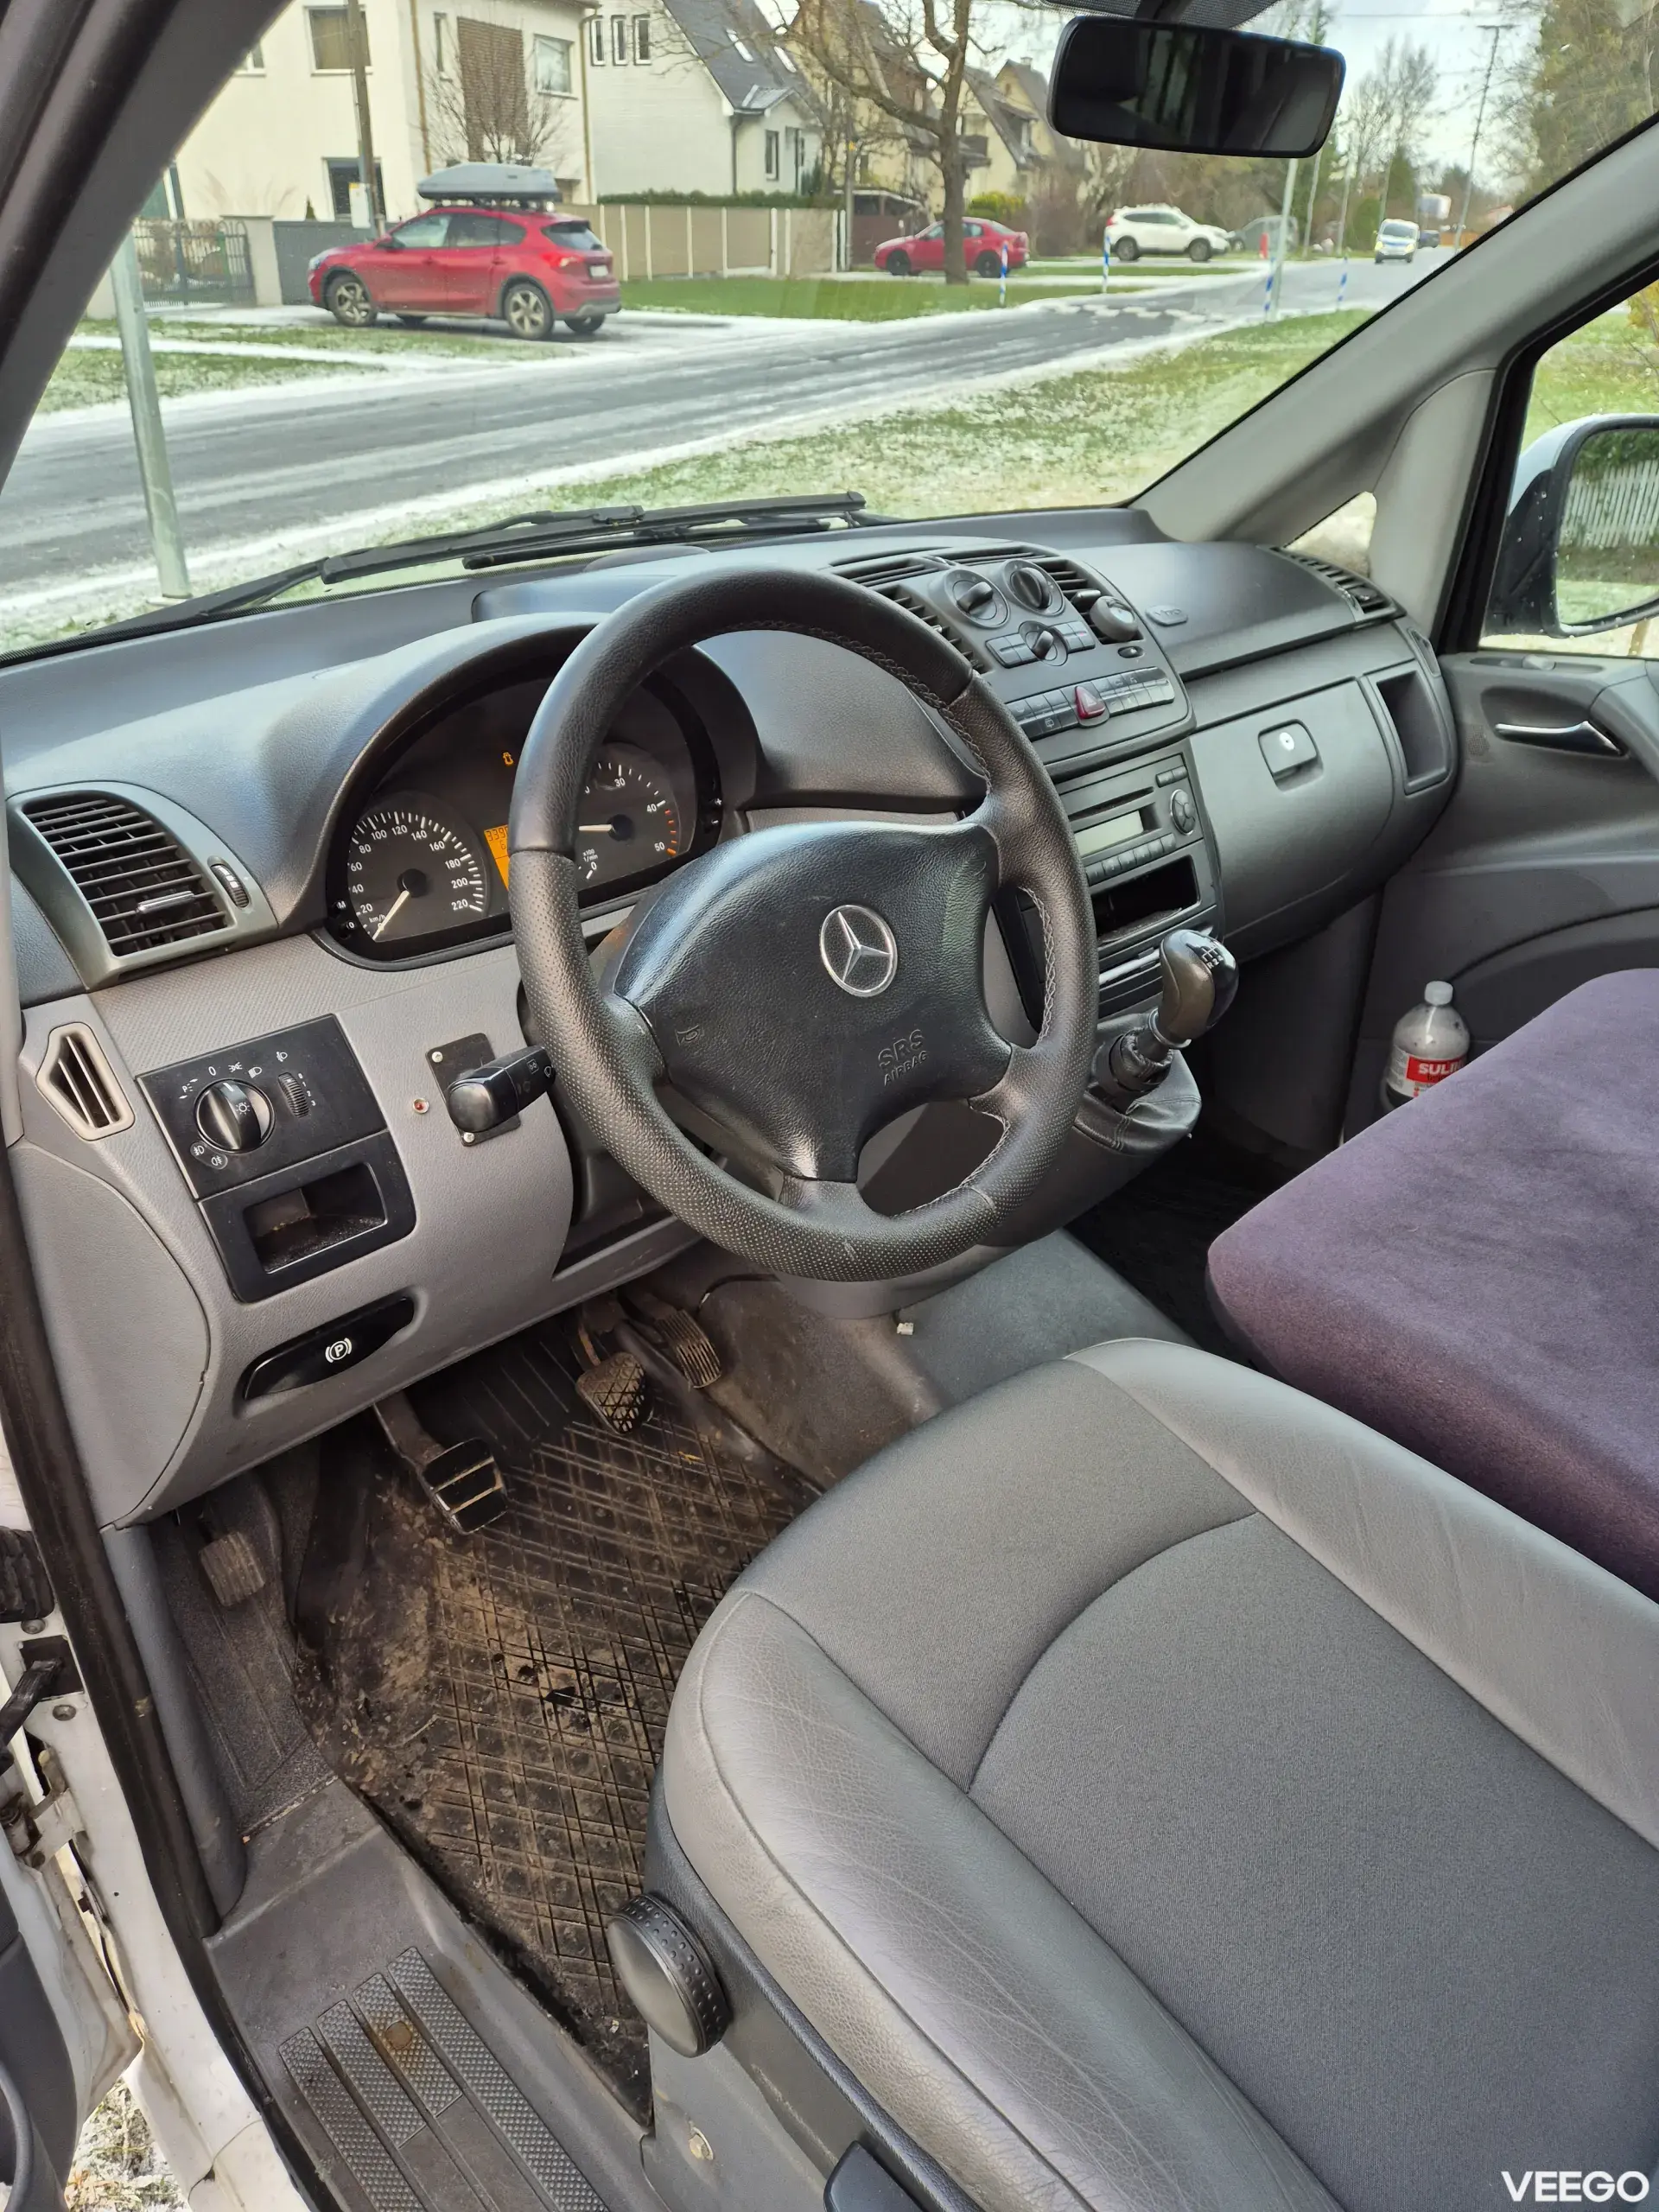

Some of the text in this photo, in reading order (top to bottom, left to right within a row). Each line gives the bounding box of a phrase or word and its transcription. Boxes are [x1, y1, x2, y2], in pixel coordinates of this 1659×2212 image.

[614, 778, 626, 787] 30
[646, 803, 657, 813] 40
[371, 830, 387, 841] 100
[391, 824, 408, 836] 120
[410, 830, 428, 841] 140
[359, 843, 372, 855] 80
[429, 841, 445, 852] 160
[654, 842, 665, 852] 50
[350, 861, 363, 872] 60
[445, 858, 461, 869] 180
[590, 861, 597, 870] 0
[352, 883, 364, 894] 40
[451, 877, 468, 889] 200
[359, 903, 373, 913] 20
[451, 899, 468, 911] 220
[368, 913, 386, 923] km/h
[878, 1029, 924, 1068] SRS
[884, 1050, 929, 1086] AIRBAG
[334, 1344, 344, 1357] P
